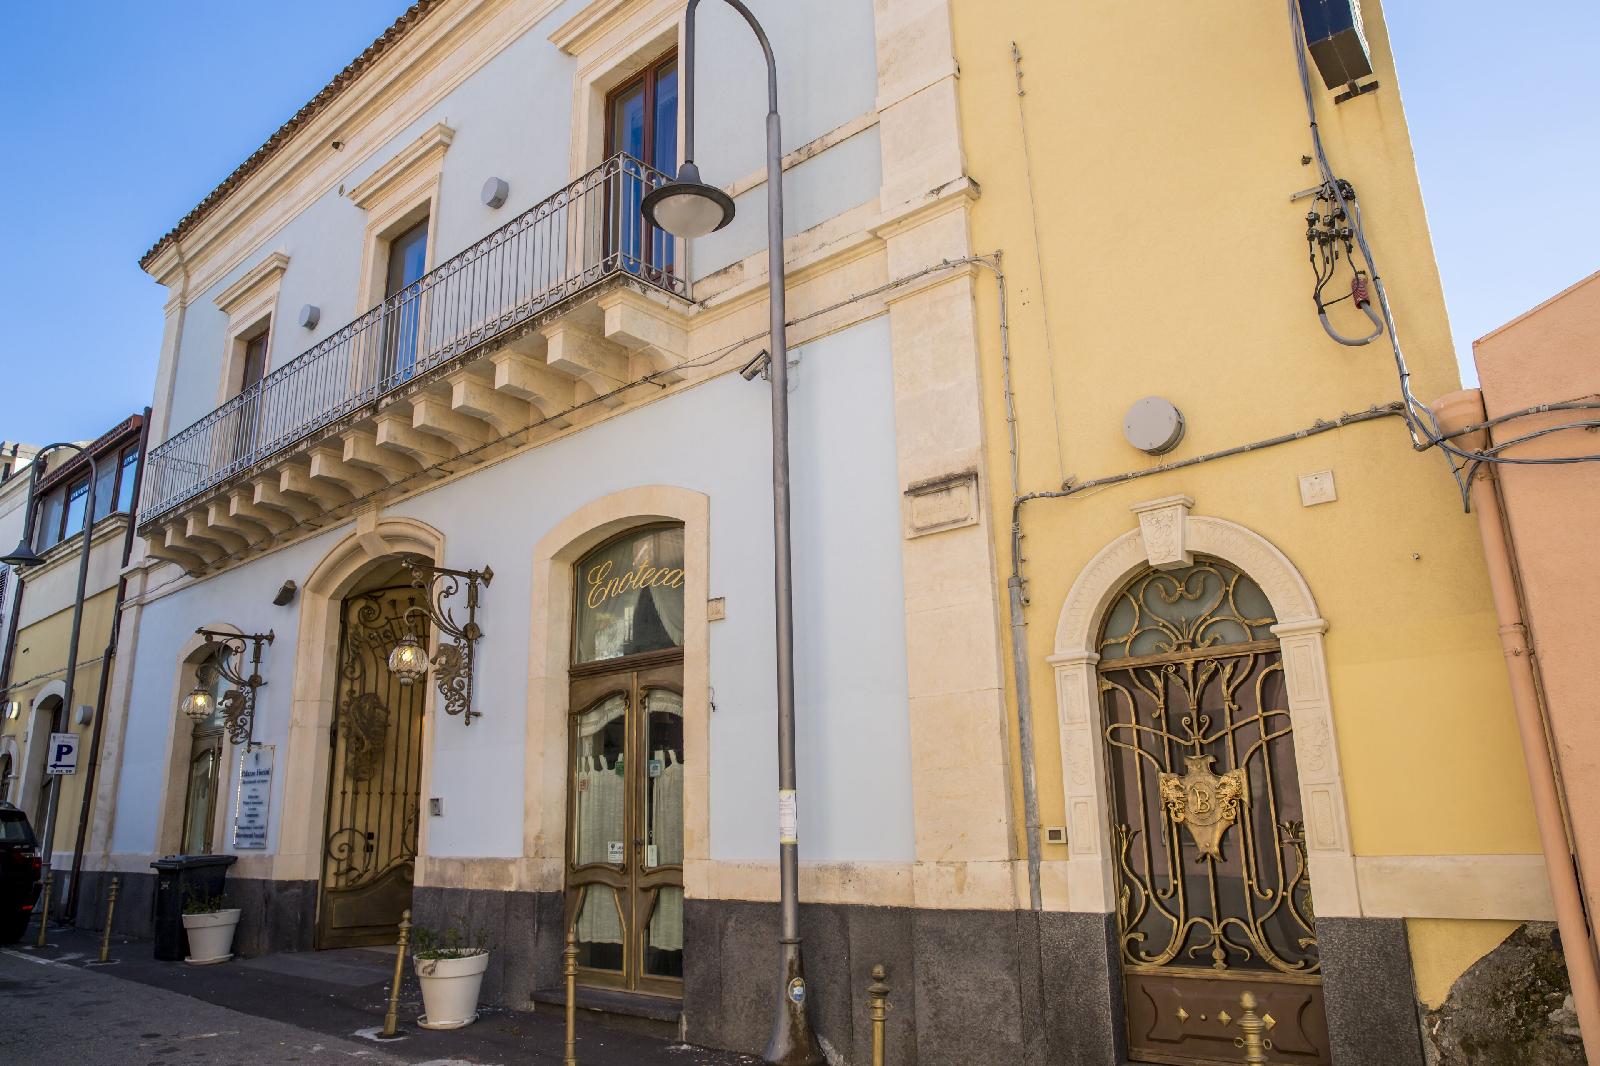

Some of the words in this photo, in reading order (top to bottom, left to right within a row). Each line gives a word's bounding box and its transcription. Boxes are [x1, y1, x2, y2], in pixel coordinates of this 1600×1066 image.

[587, 560, 684, 609] Enoteca
[55, 744, 74, 762] P
[1191, 788, 1211, 814] B
